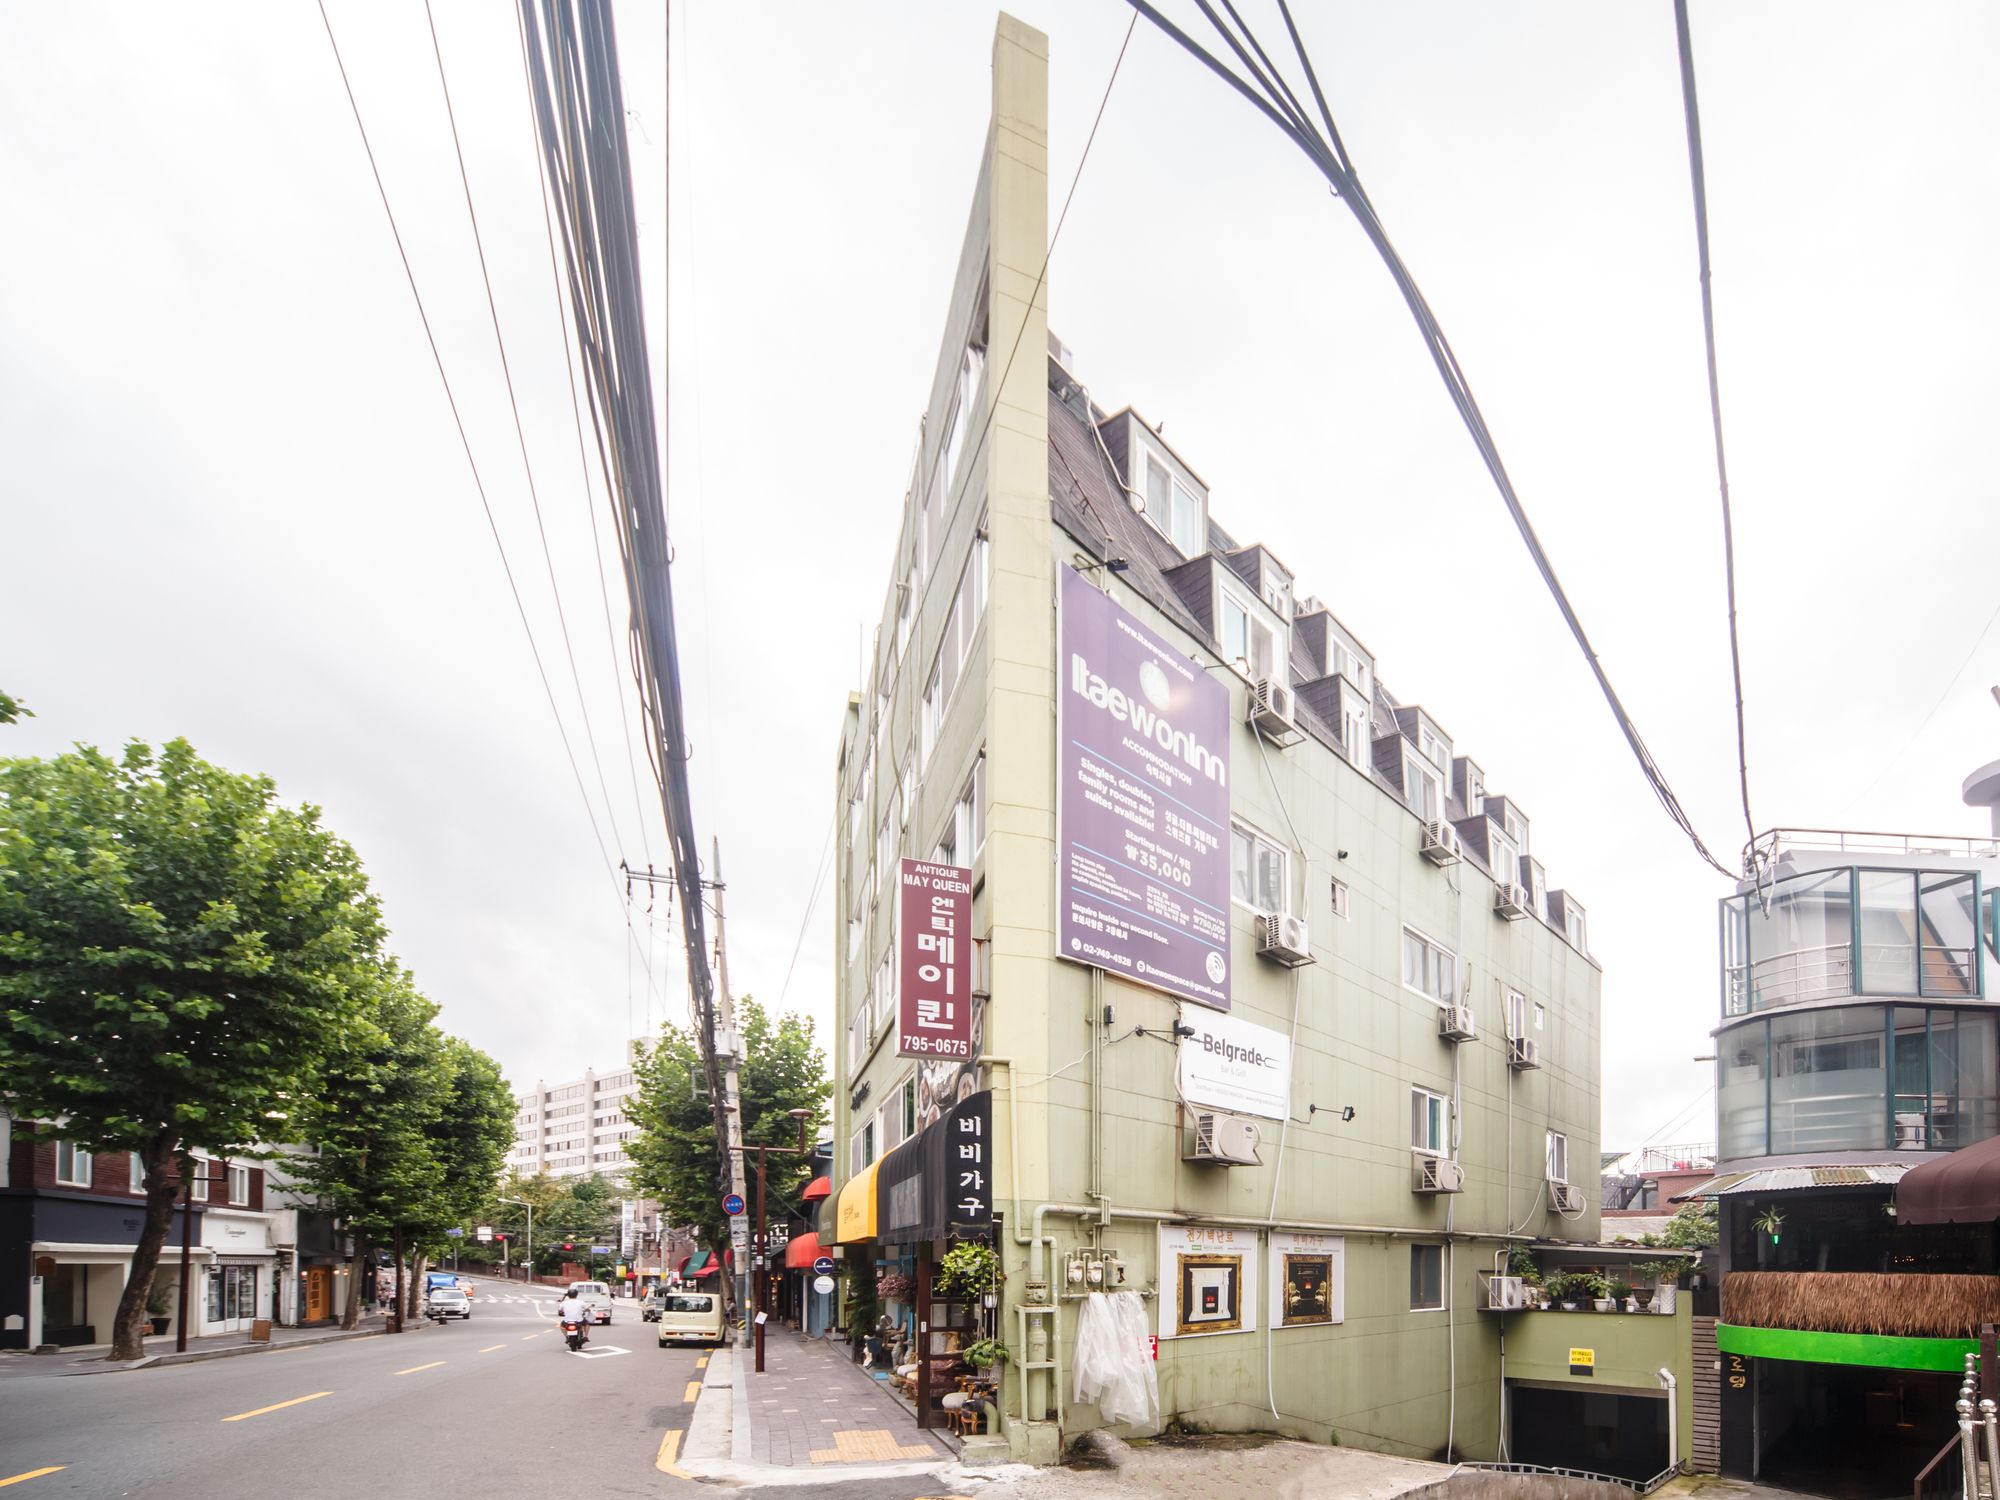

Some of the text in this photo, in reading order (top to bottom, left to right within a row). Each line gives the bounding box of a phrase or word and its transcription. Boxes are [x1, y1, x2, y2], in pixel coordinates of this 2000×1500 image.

[1073, 652, 1225, 787] ItaewonInn
[1123, 736, 1192, 786] ACCOMMODATION
[1078, 770, 1155, 819] family rooms and
[1081, 757, 1155, 806] Singles, doubles,
[1085, 788, 1155, 832] suites available!
[1125, 829, 1155, 851] Starting
[1157, 845, 1173, 860] from
[904, 873, 970, 895] MAY QUEEN
[915, 863, 959, 879] ANTIQUE
[1072, 902, 1169, 944] Inquire inside on second floor.
[1084, 943, 1132, 968] 02-749-4528
[904, 1036, 967, 1055] 795-0675
[1203, 1032, 1262, 1066] Belgrade
[957, 1115, 985, 1217] 비비가구
[1186, 1228, 1234, 1243] 전기벽난로
